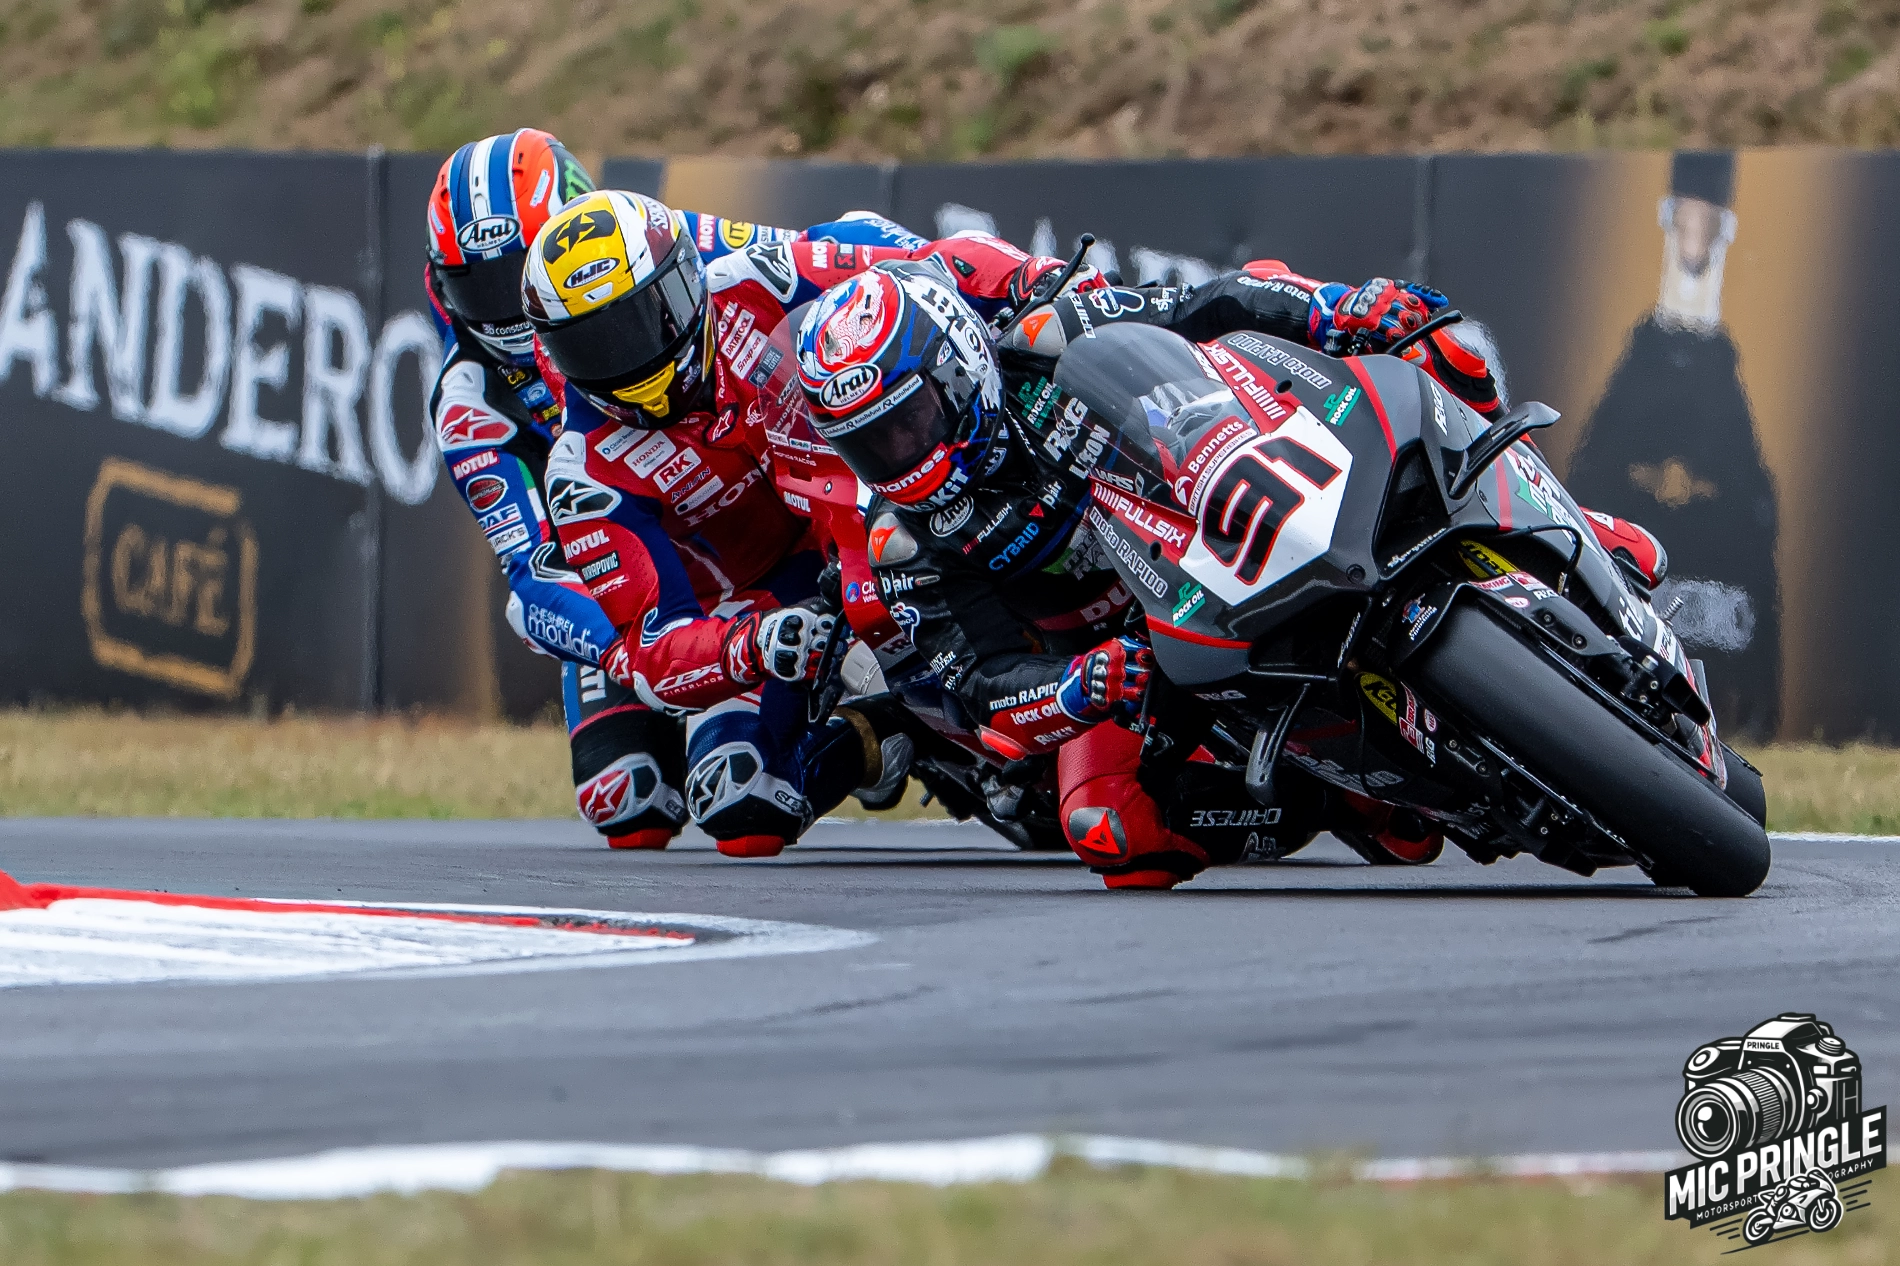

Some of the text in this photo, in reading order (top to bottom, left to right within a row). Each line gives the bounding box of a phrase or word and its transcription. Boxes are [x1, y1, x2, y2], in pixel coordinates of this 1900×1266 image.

[461, 218, 511, 246] Arai
[570, 260, 611, 286] HJC
[1227, 333, 1289, 366] RAPIDO
[827, 366, 870, 406] Arai
[1283, 359, 1332, 390] moto
[1331, 387, 1358, 426] ROCK OIL
[1043, 397, 1088, 461] R&G
[632, 441, 665, 467] HONDA
[1069, 424, 1111, 480] LEON
[1188, 421, 1243, 474] Bennetts
[453, 451, 497, 480] MOTUL
[659, 454, 693, 485] RK
[1190, 430, 1253, 512] BRITISH SUPERBIKES
[783, 491, 811, 512] MOTUL
[1202, 436, 1342, 587] 91
[1116, 497, 1187, 549] FULLSIX
[564, 529, 610, 560] MOTUL
[989, 522, 1040, 571] CYBRID
[1089, 506, 1119, 549] moto
[1117, 538, 1168, 598] RAPIDO
[1173, 589, 1204, 622] ROCK OIL
[528, 615, 601, 662] mouldin
[990, 682, 1059, 711] moto RAPID
[1190, 808, 1282, 827] DAINESE
